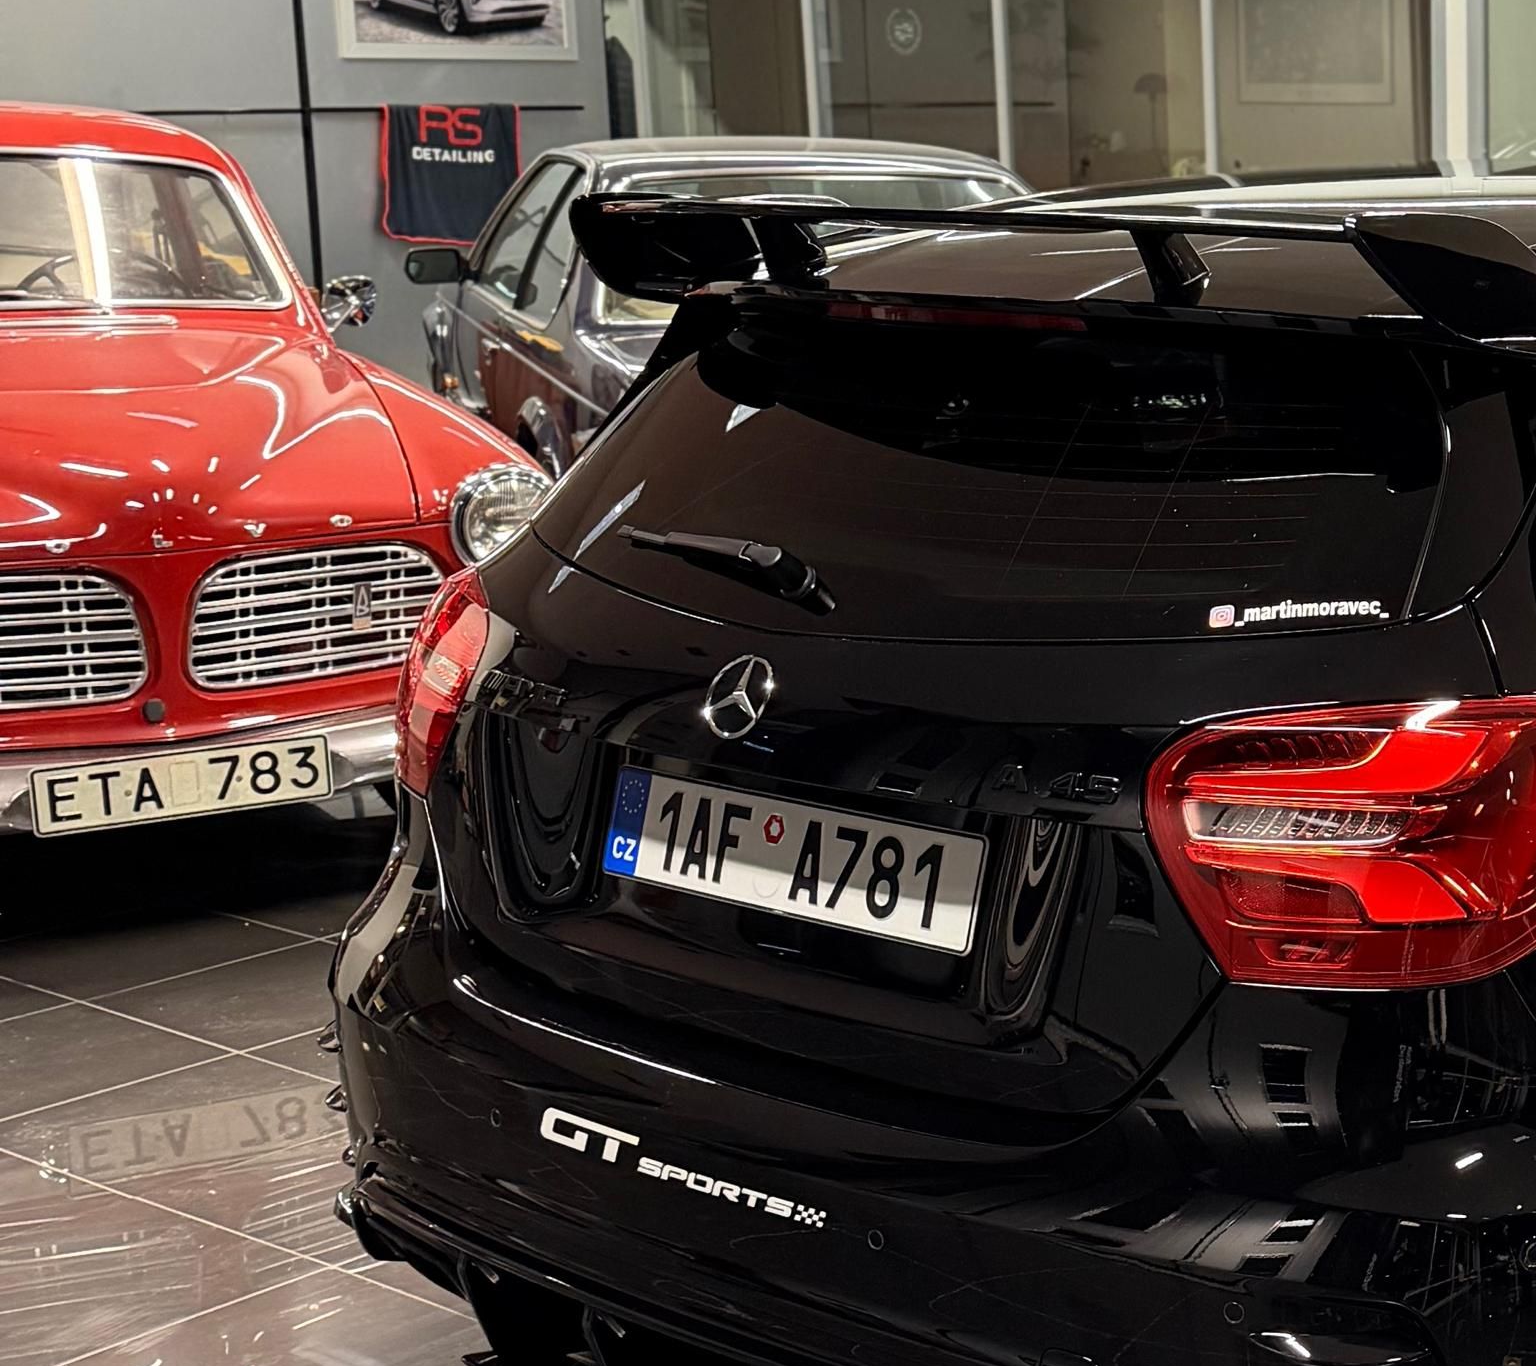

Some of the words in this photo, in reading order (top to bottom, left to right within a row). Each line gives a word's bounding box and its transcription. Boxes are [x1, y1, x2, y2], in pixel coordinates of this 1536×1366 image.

[419, 104, 483, 147] RS
[411, 146, 496, 163] DETAILING
[1234, 599, 1390, 627] _martinmoravec_
[46, 766, 165, 824] ETA
[207, 744, 320, 801] 783
[611, 834, 636, 863] CZ
[659, 791, 753, 885] 1AF
[786, 819, 945, 931] A781
[540, 1107, 640, 1163] GT
[637, 1156, 795, 1218] SPORTS
